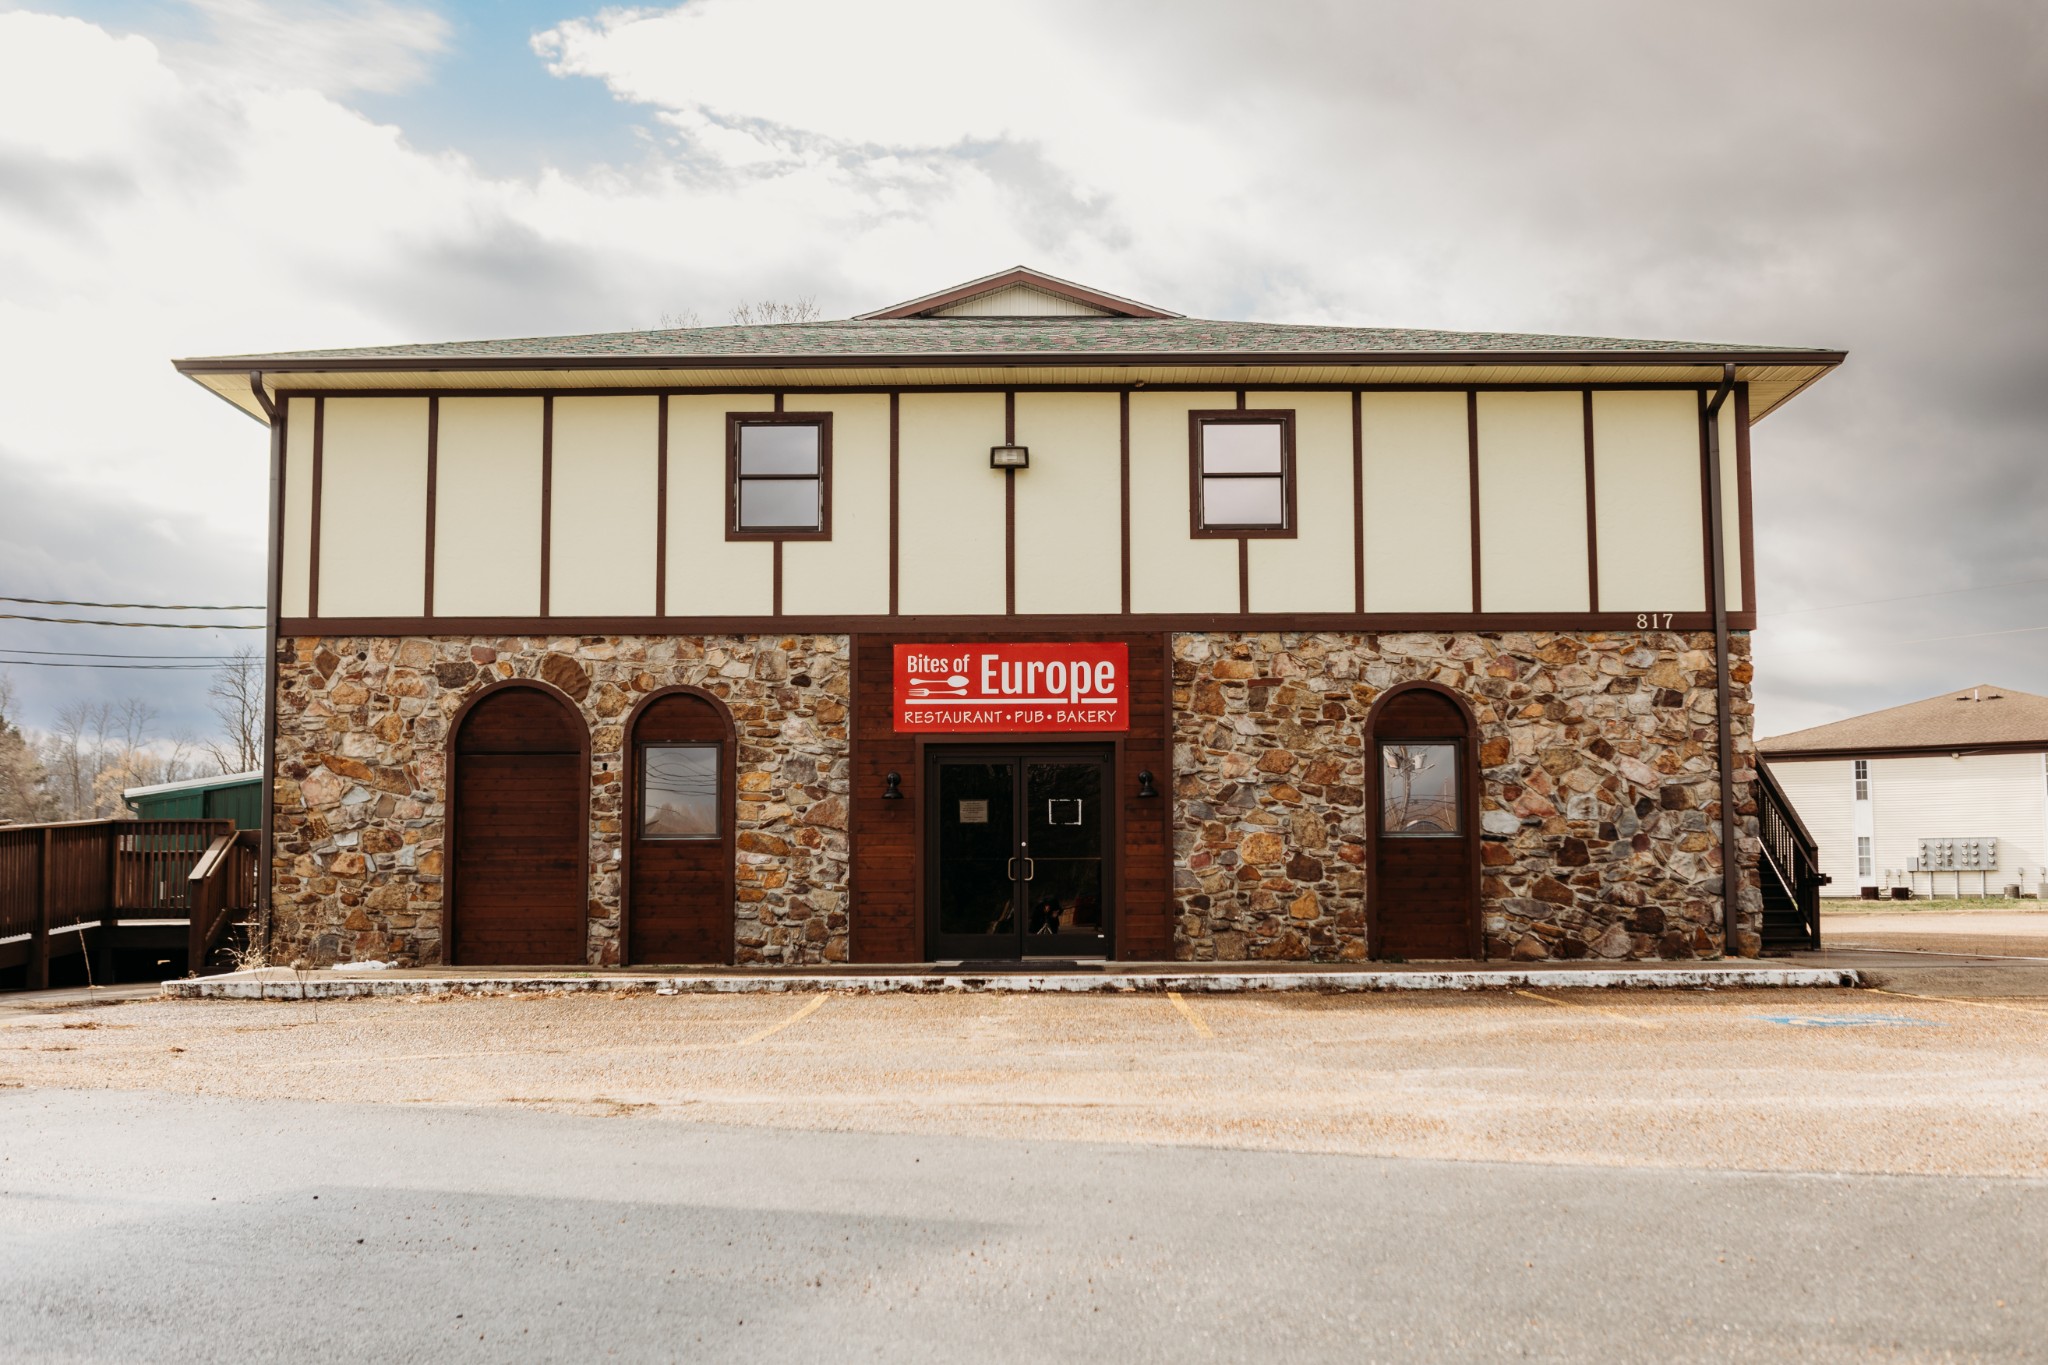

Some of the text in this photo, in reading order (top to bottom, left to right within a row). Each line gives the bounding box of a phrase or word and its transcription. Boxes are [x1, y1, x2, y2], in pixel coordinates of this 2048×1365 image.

[1636, 613, 1673, 630] 817
[907, 654, 970, 673] Bites of
[981, 654, 1115, 704] Europe
[904, 710, 1117, 724] RESTAURANT PUB BAKERY
